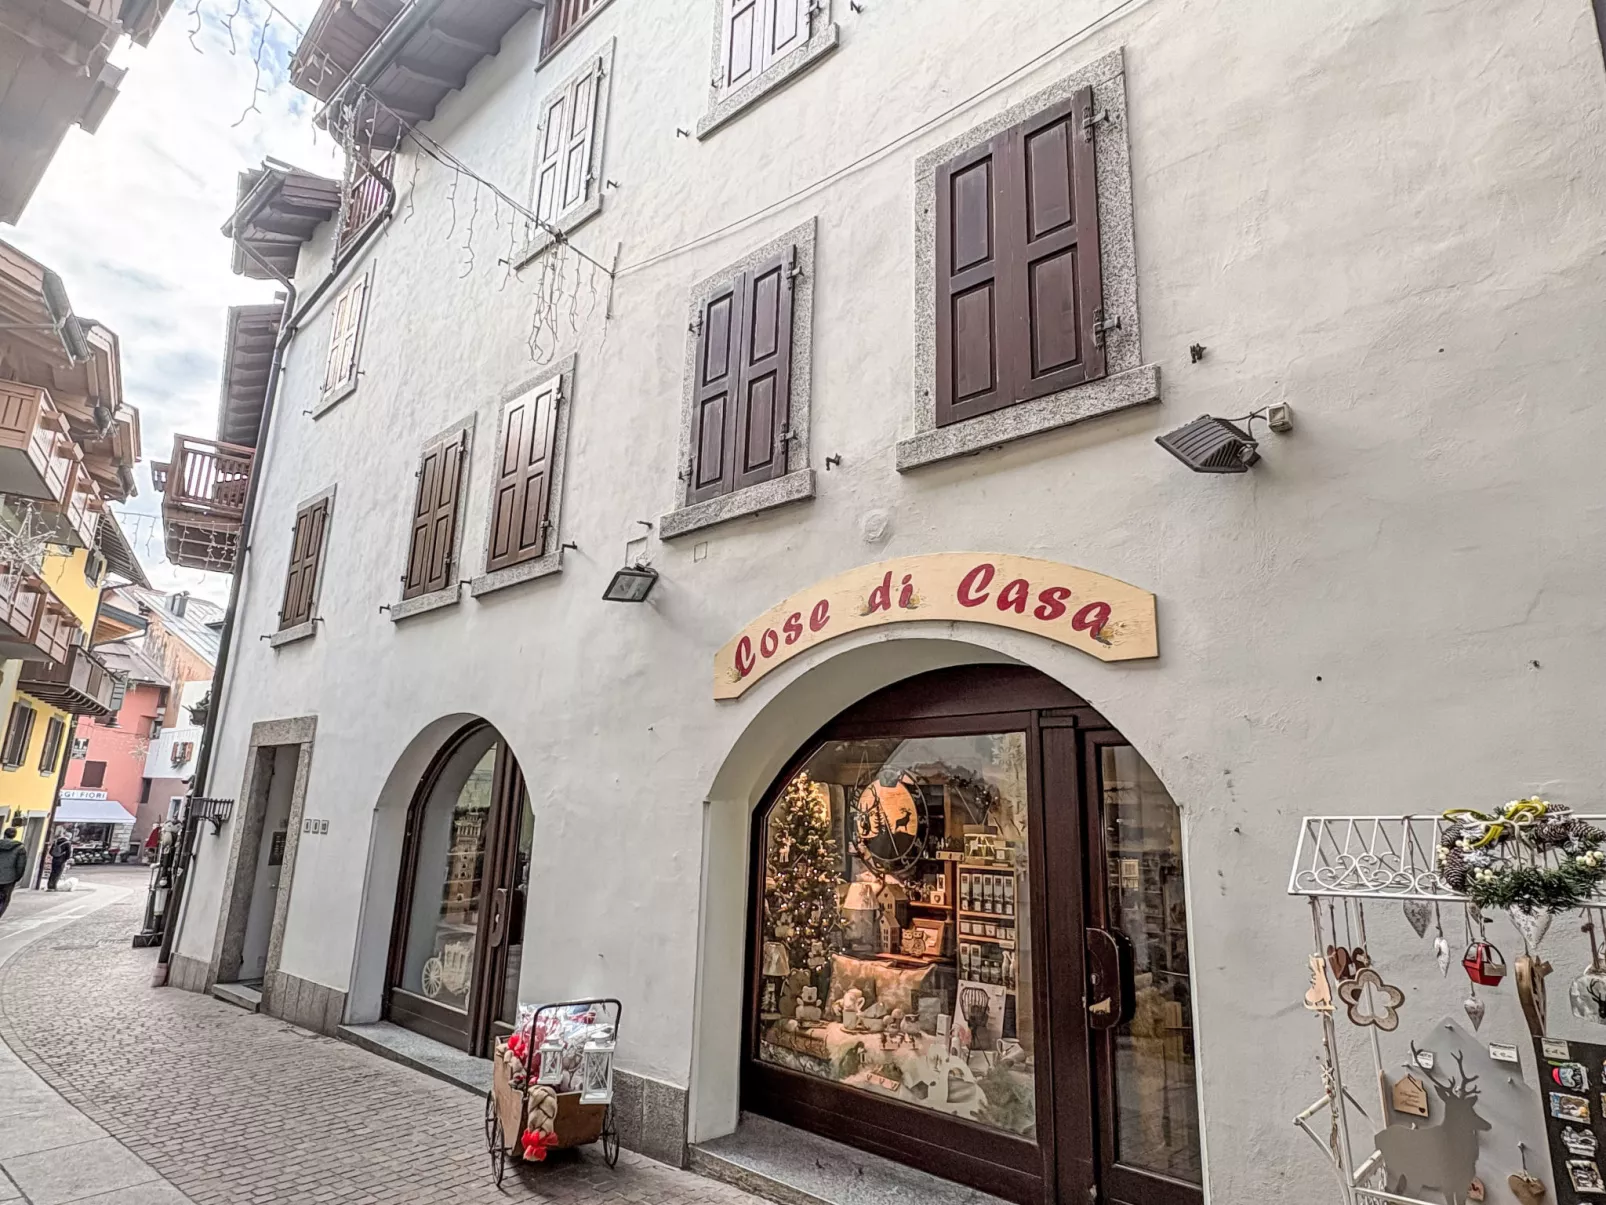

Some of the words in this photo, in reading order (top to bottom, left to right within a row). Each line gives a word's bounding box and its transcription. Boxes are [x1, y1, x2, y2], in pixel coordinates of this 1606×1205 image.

[734, 598, 831, 678] Cose
[868, 570, 914, 614] di
[956, 563, 1112, 641] Casa
[80, 791, 106, 799] FIORI
